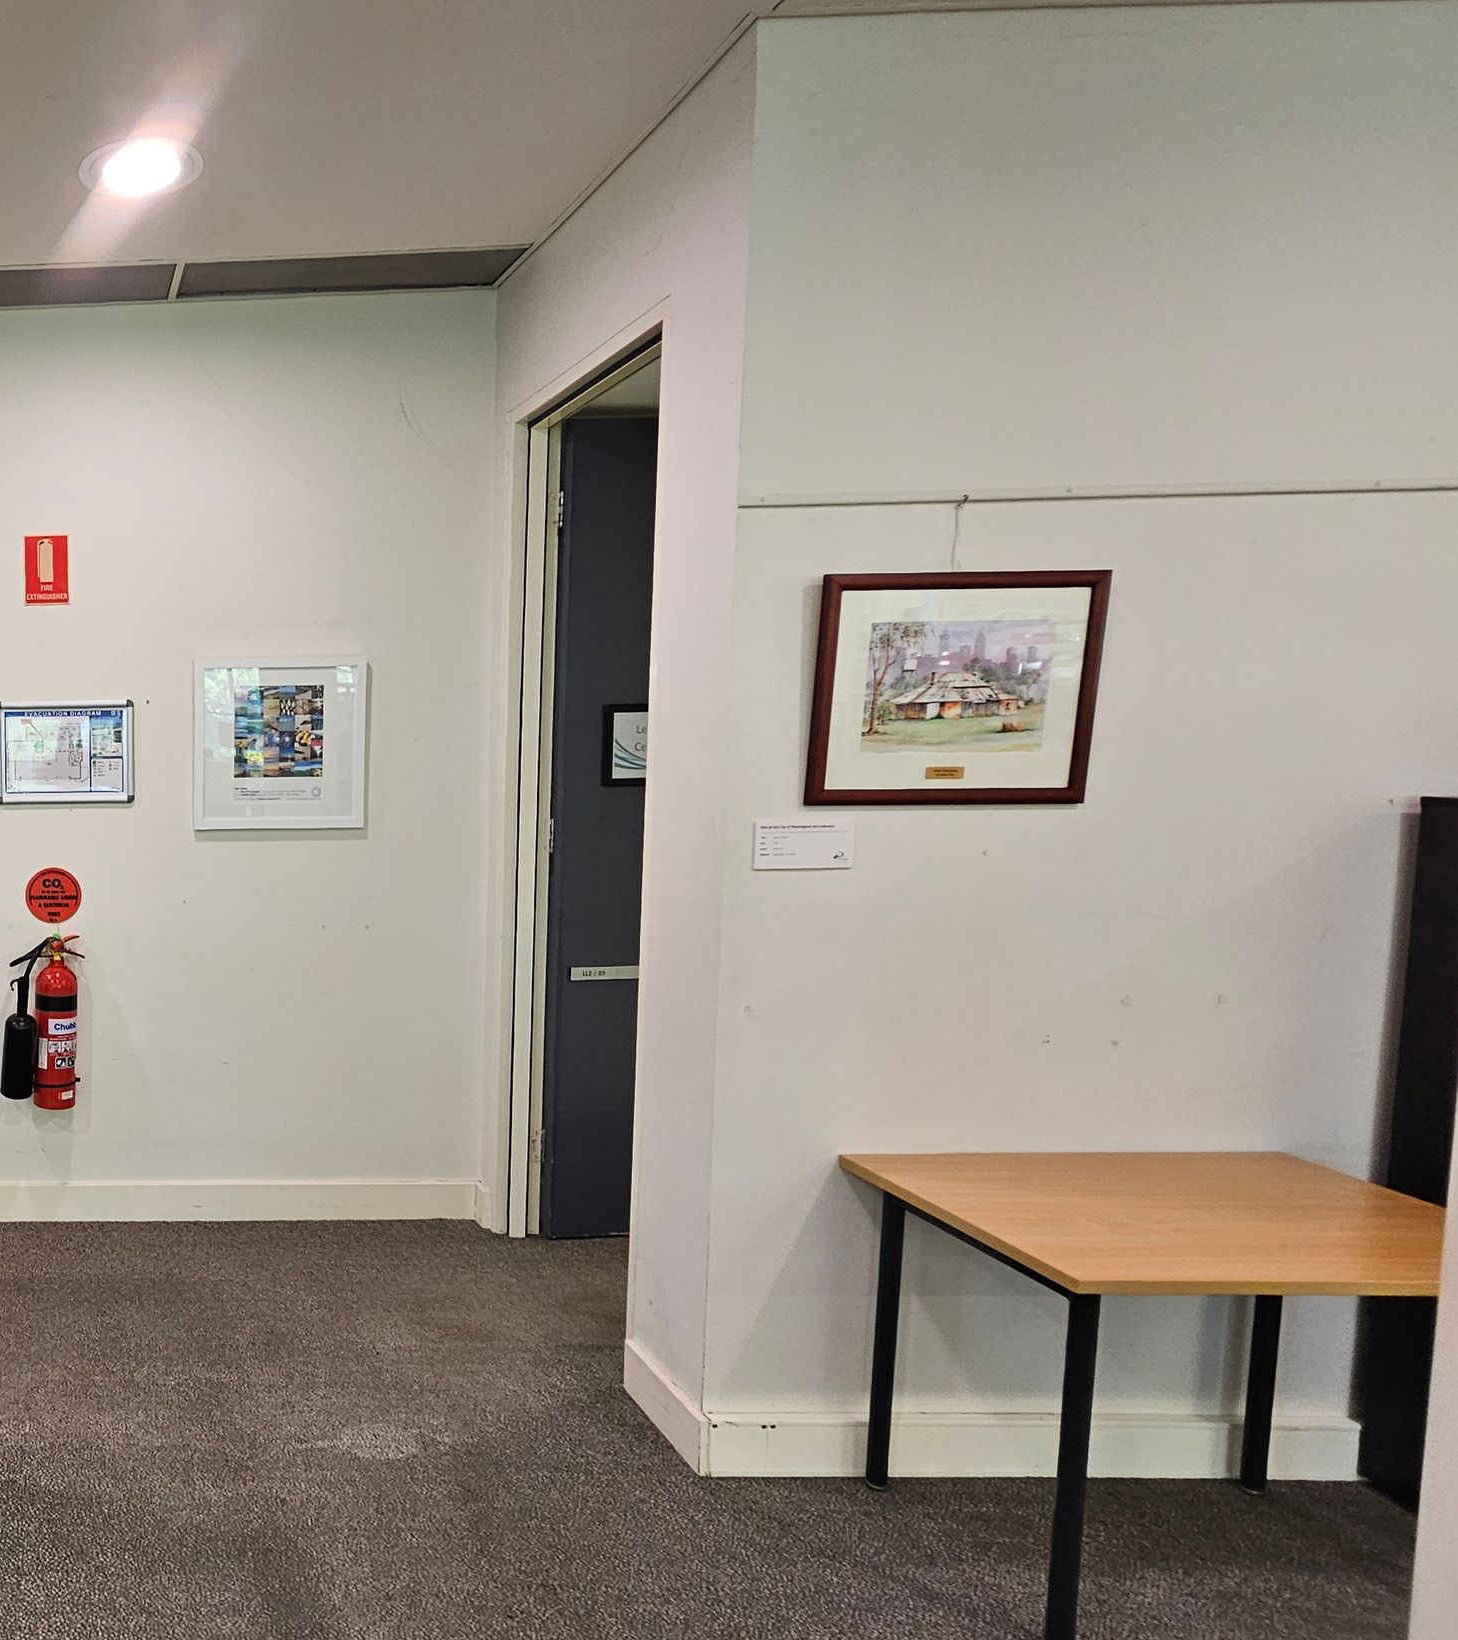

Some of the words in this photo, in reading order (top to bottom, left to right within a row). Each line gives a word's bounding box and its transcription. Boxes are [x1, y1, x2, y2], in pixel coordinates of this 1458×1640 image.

[40, 584, 54, 592] FIRE
[26, 592, 68, 601] EXTINGUISHER
[69, 709, 102, 717] DIAGRAM
